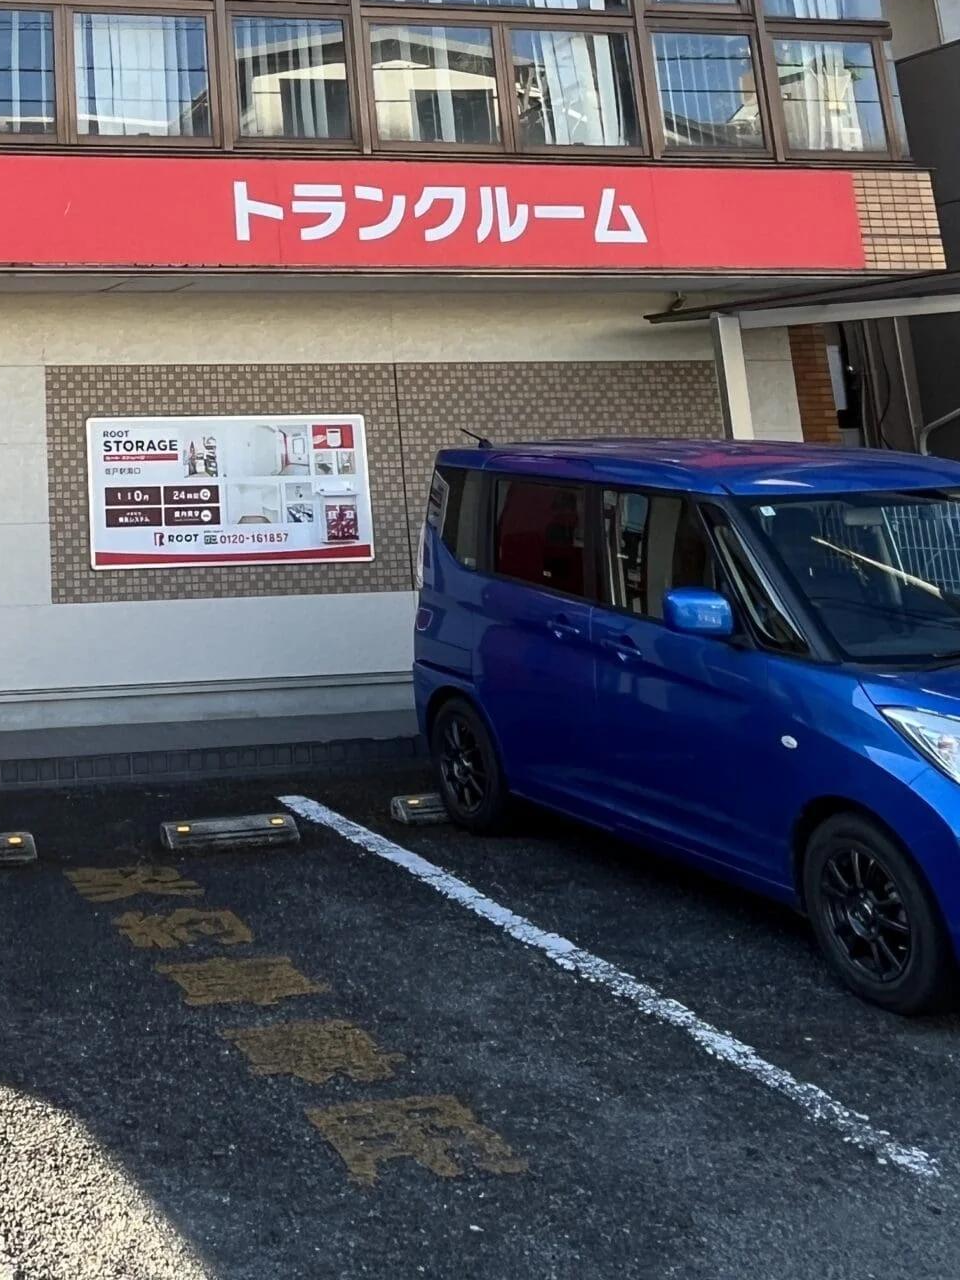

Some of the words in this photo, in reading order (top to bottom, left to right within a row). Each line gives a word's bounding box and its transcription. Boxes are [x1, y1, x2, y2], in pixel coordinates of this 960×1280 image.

[233, 181, 648, 244] トランクルーム
[103, 430, 129, 438] ROOT
[103, 440, 178, 452] STORAGE
[168, 534, 199, 543] ROOT
[220, 533, 289, 544] 0120-161857
